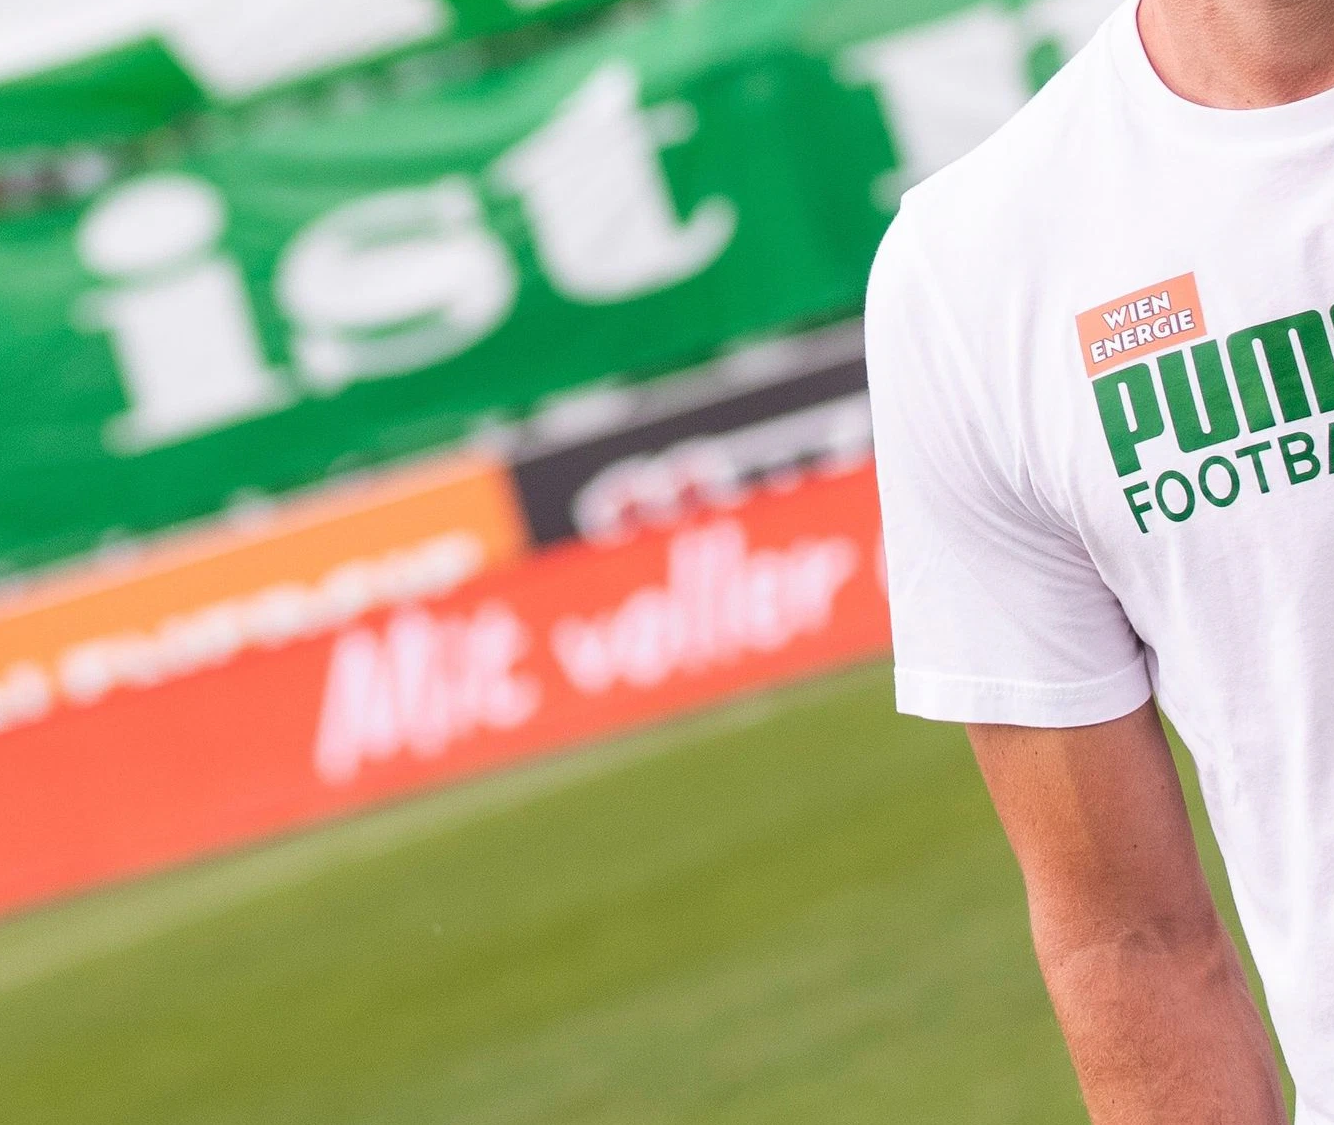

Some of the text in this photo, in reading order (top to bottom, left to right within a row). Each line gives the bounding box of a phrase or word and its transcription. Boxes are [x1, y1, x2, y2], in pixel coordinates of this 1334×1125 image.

[72, 58, 737, 457] ist
[1089, 307, 1196, 363] ENERGIE
[1101, 290, 1172, 333] WIEN
